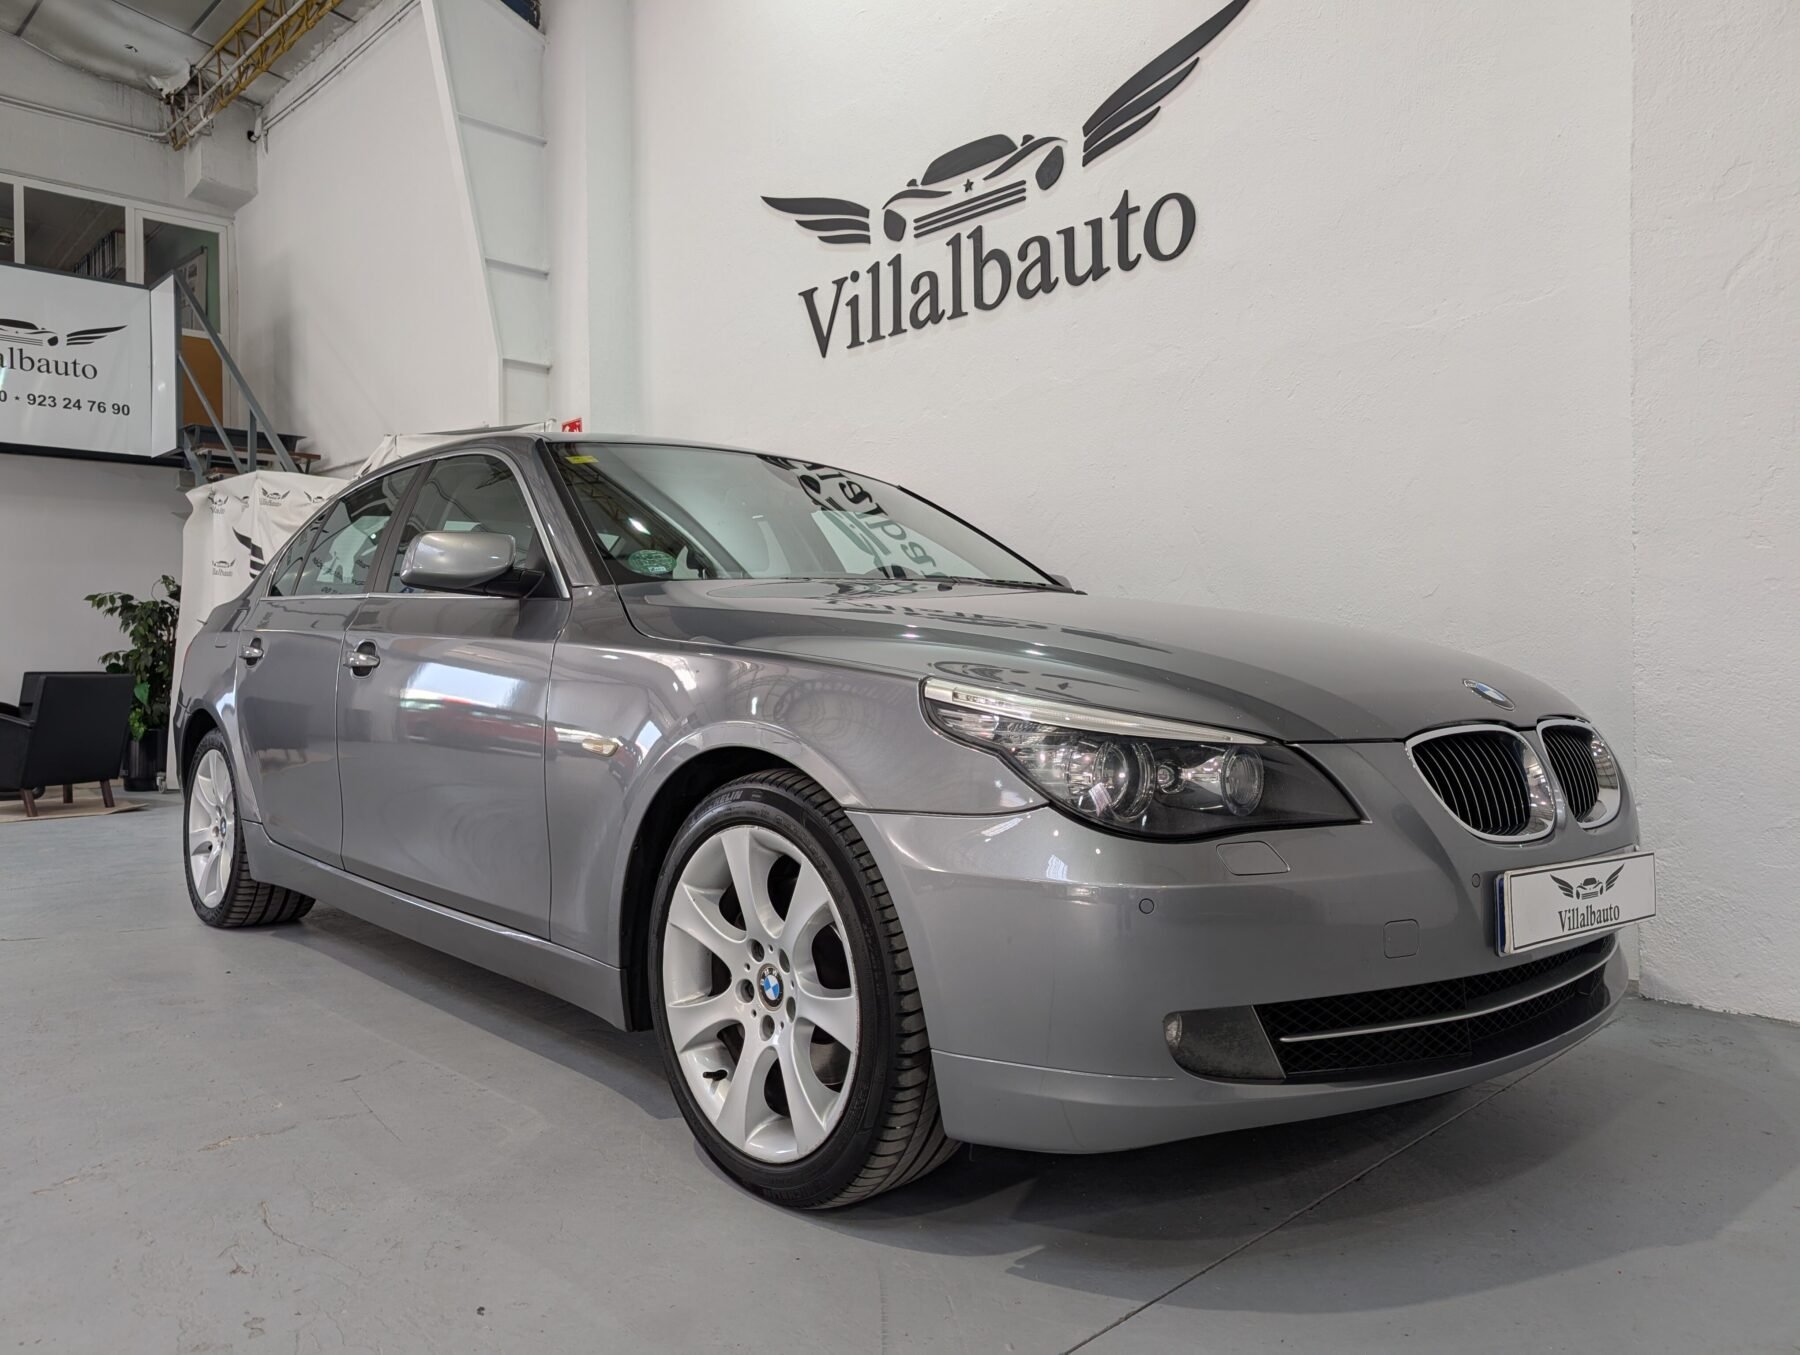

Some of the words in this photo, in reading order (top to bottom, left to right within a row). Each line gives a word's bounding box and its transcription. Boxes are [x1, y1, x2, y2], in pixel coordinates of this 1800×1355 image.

[798, 190, 1196, 358] Villalbauto
[27, 393, 57, 408] 923
[62, 397, 82, 411] 24
[87, 400, 107, 414] 76
[112, 403, 130, 416] 90
[1558, 904, 1620, 932] Villalbauto
